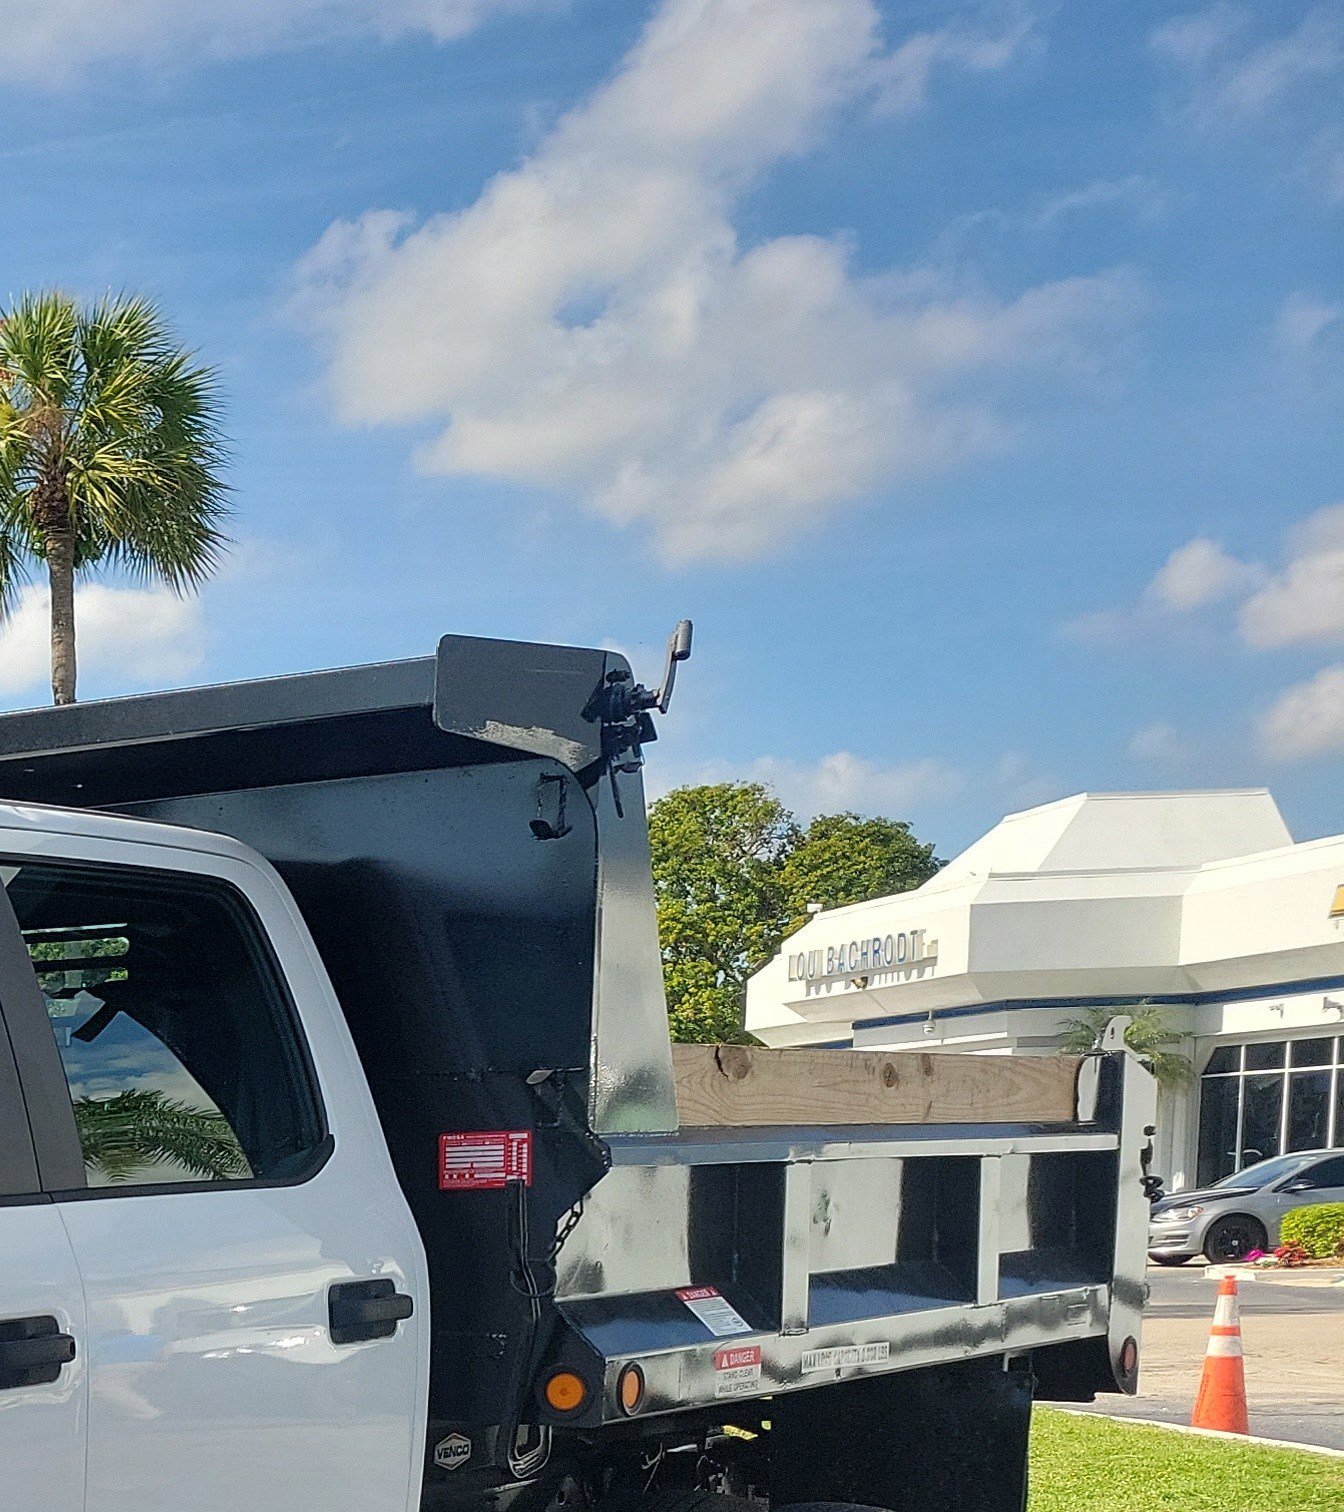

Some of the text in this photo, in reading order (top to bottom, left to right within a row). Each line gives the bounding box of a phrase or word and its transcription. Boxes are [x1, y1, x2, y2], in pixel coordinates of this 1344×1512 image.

[826, 930, 925, 975] BACHRODT
[729, 1350, 755, 1365] DANGER
[436, 1443, 470, 1460] VENCO
